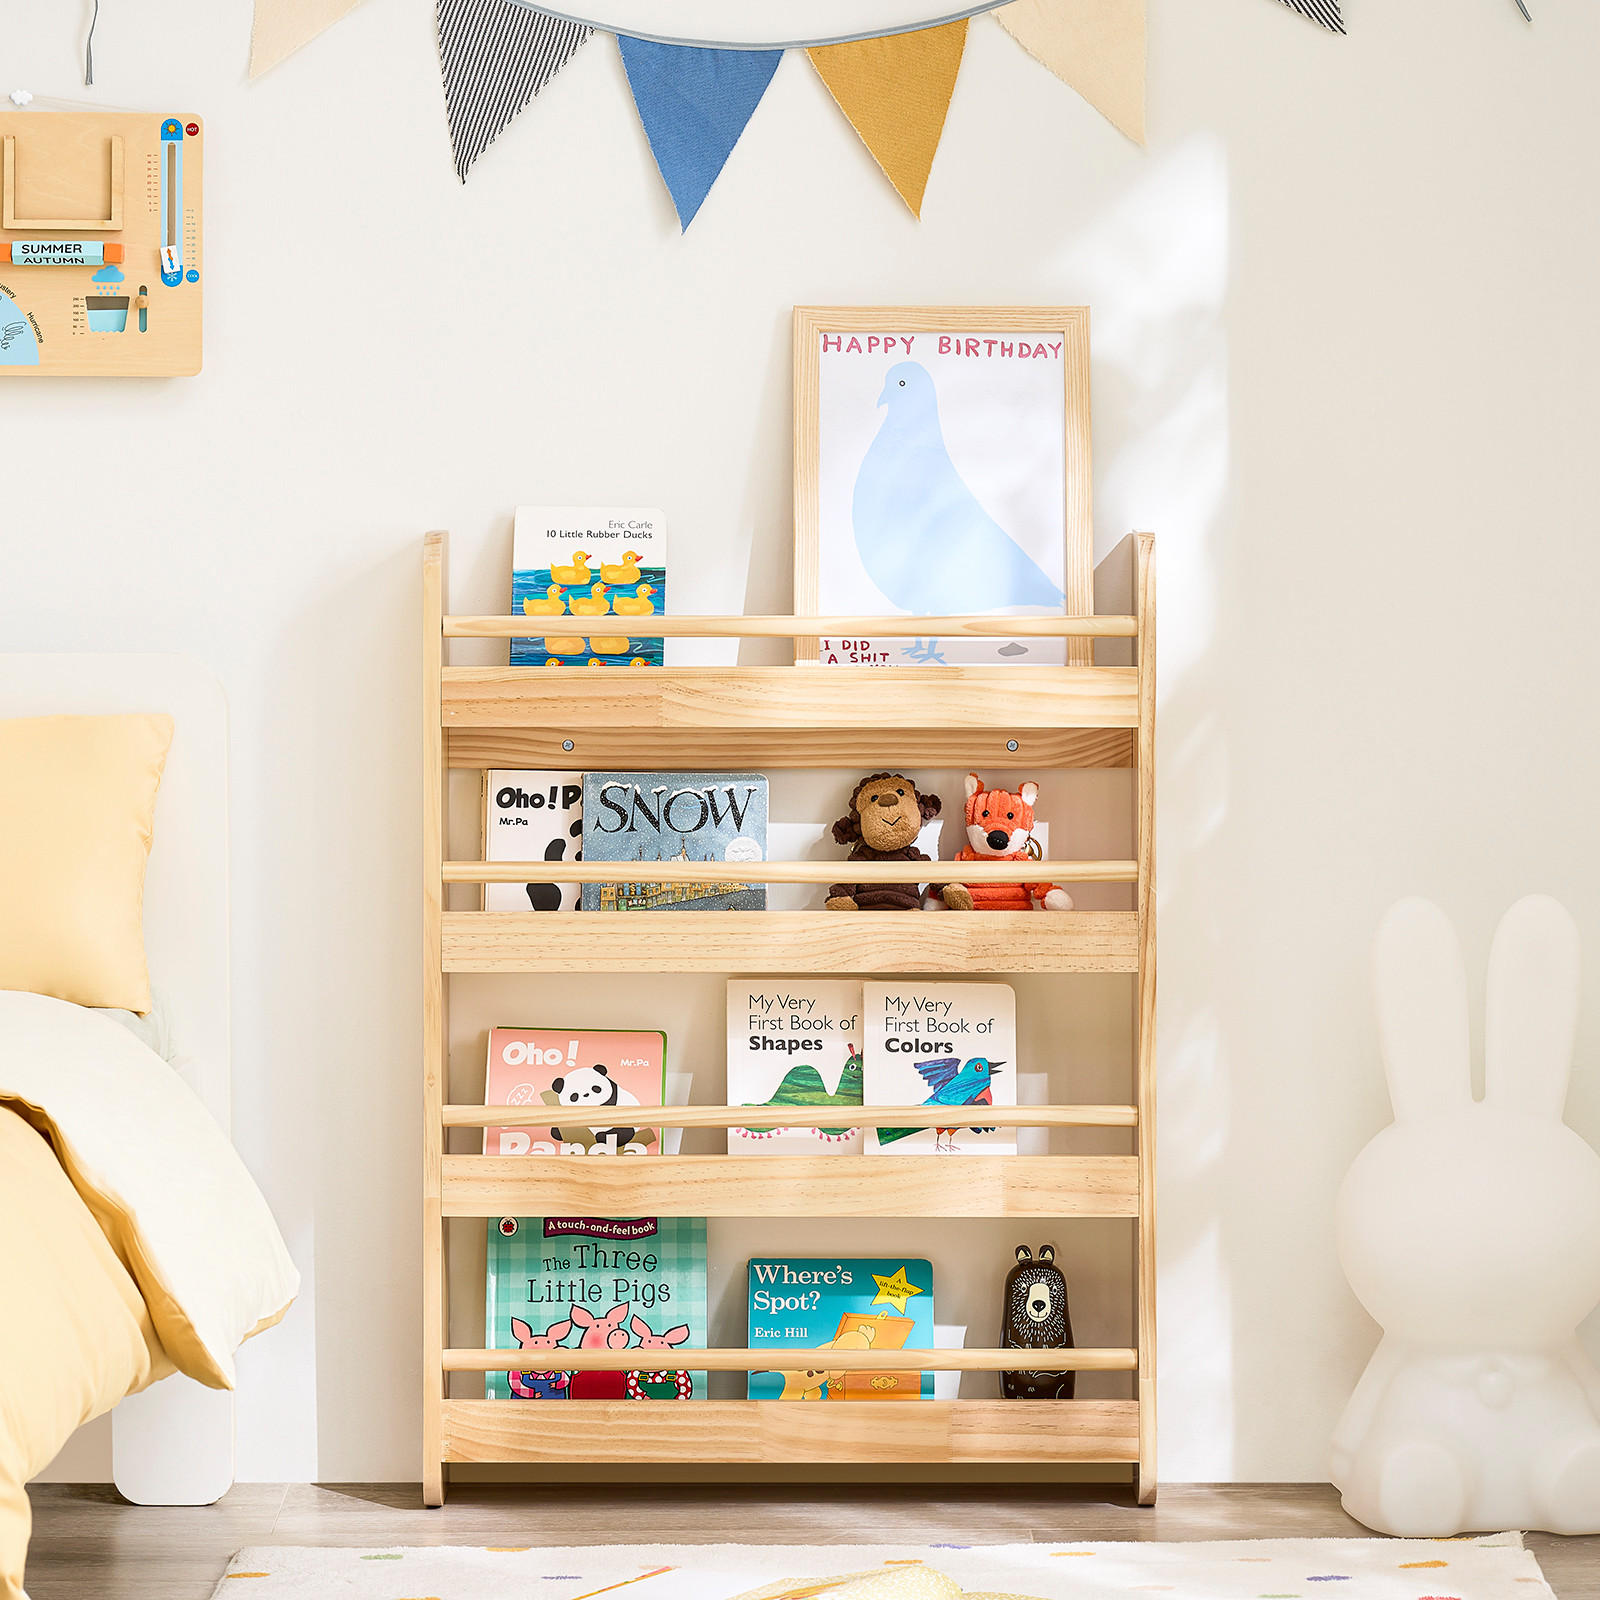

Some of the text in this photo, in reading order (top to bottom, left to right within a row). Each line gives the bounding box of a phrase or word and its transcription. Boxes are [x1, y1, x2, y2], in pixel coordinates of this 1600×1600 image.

[21, 243, 82, 254] SUMMER
[27, 312, 44, 343] Hurricane
[822, 334, 1062, 360] HAPPY BIRTHDAY
[608, 520, 653, 530] Eric Carle
[546, 530, 653, 539] 10 Little Rubber Ducks
[824, 640, 870, 651] I DID
[828, 652, 889, 664] A SHIT
[593, 782, 758, 834] SNOW
[499, 817, 528, 826] Mr.Pa
[749, 994, 816, 1014] My Very
[885, 996, 953, 1017] My Very
[749, 1014, 858, 1031] First Book of
[885, 1017, 995, 1034] First Book of
[502, 1040, 579, 1067] Oho!
[749, 1036, 823, 1055] Shapes
[885, 1037, 954, 1054] Colors
[620, 1058, 649, 1067] Mr.Pa
[548, 1220, 655, 1235] A touch-and-feel book
[543, 1243, 658, 1272] The Three
[753, 1265, 853, 1285] Where's
[527, 1278, 671, 1308] Little Pigs
[886, 1291, 900, 1299] book
[753, 1291, 821, 1315] Spot?
[754, 1327, 808, 1338] Eric Hill
